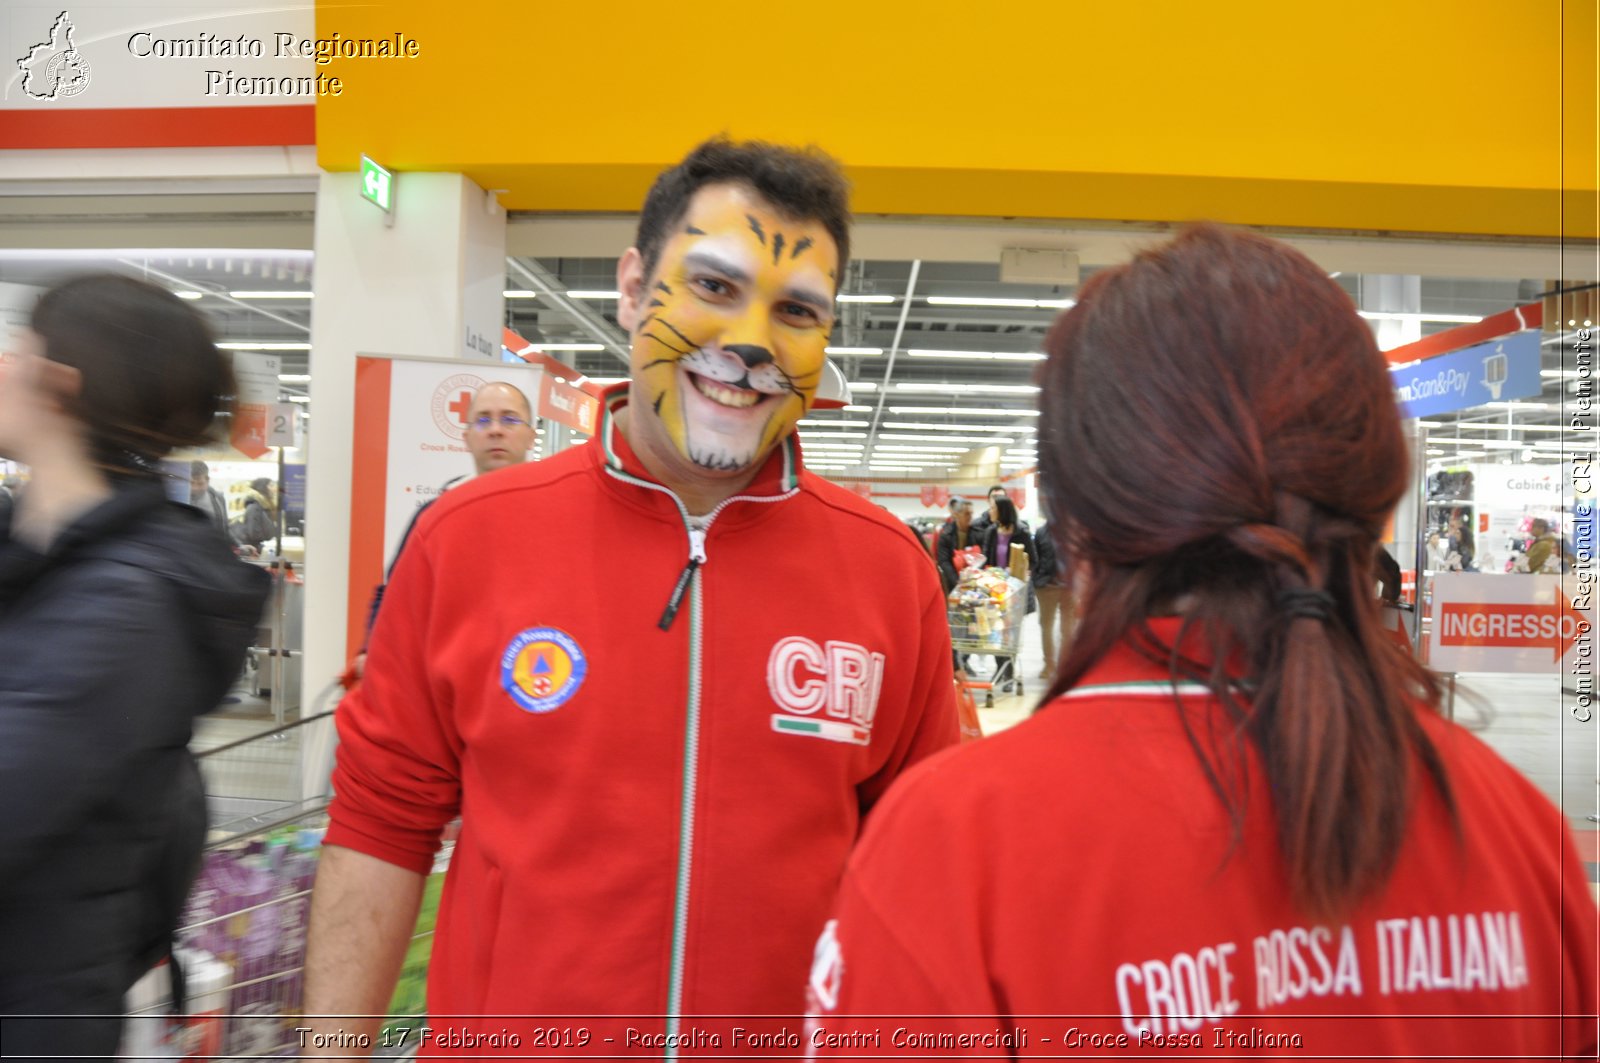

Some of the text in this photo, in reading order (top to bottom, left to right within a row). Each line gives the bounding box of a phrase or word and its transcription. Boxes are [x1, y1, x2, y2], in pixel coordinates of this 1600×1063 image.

[273, 415, 286, 433] 2
[1443, 612, 1575, 639] INGRESSO
[766, 635, 886, 729] CRI
[1115, 911, 1529, 1040] CROCE ROSSA ITALIANA
